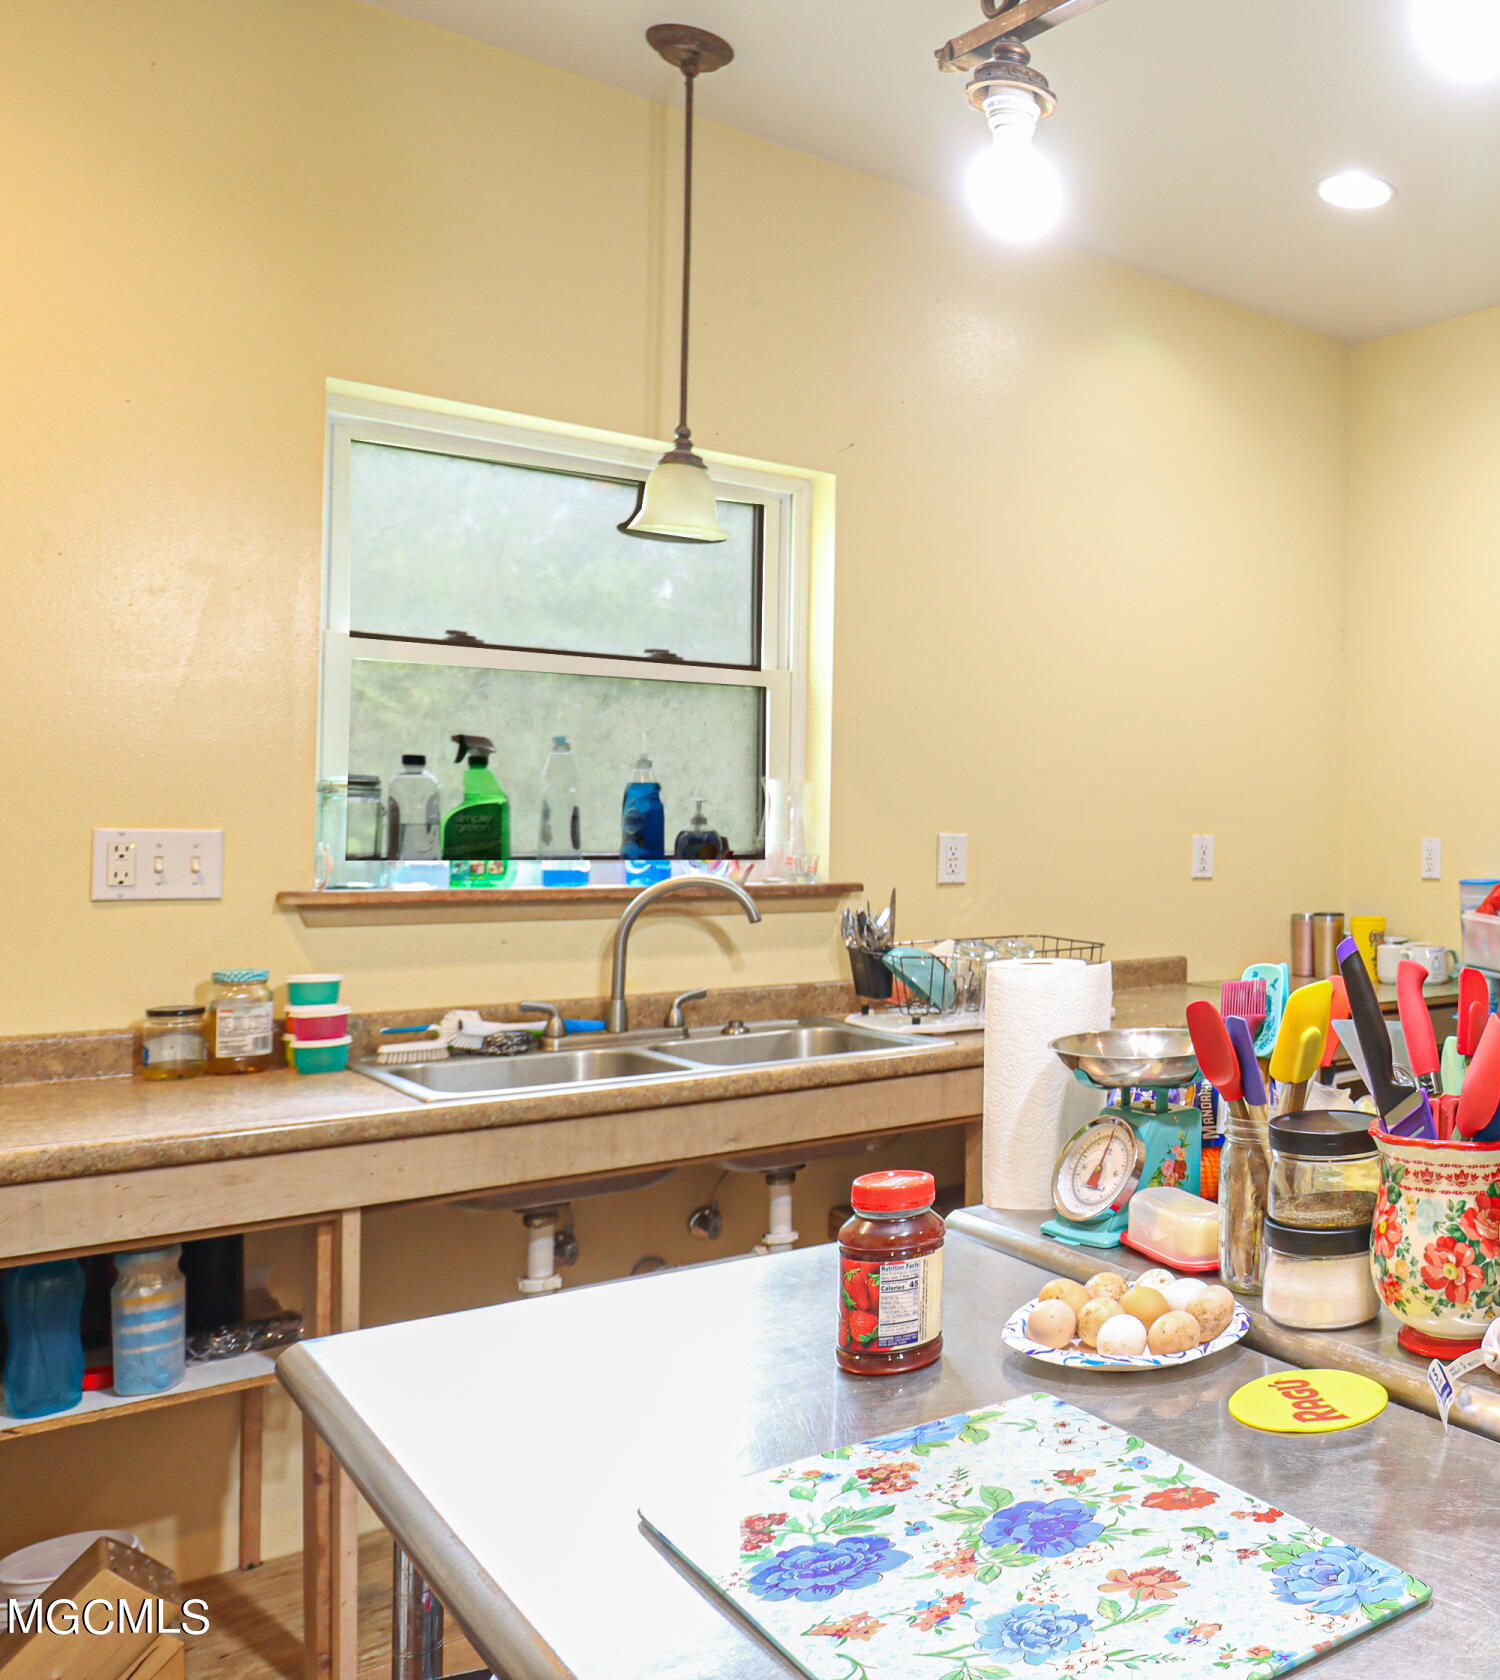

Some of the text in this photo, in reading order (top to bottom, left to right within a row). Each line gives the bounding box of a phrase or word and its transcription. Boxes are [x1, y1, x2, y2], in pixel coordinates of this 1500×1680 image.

[881, 1264, 905, 1272] Nutrition
[881, 1284, 905, 1292] Calories
[909, 1279, 919, 1288] 45
[1268, 1378, 1351, 1423] RAGÚ
